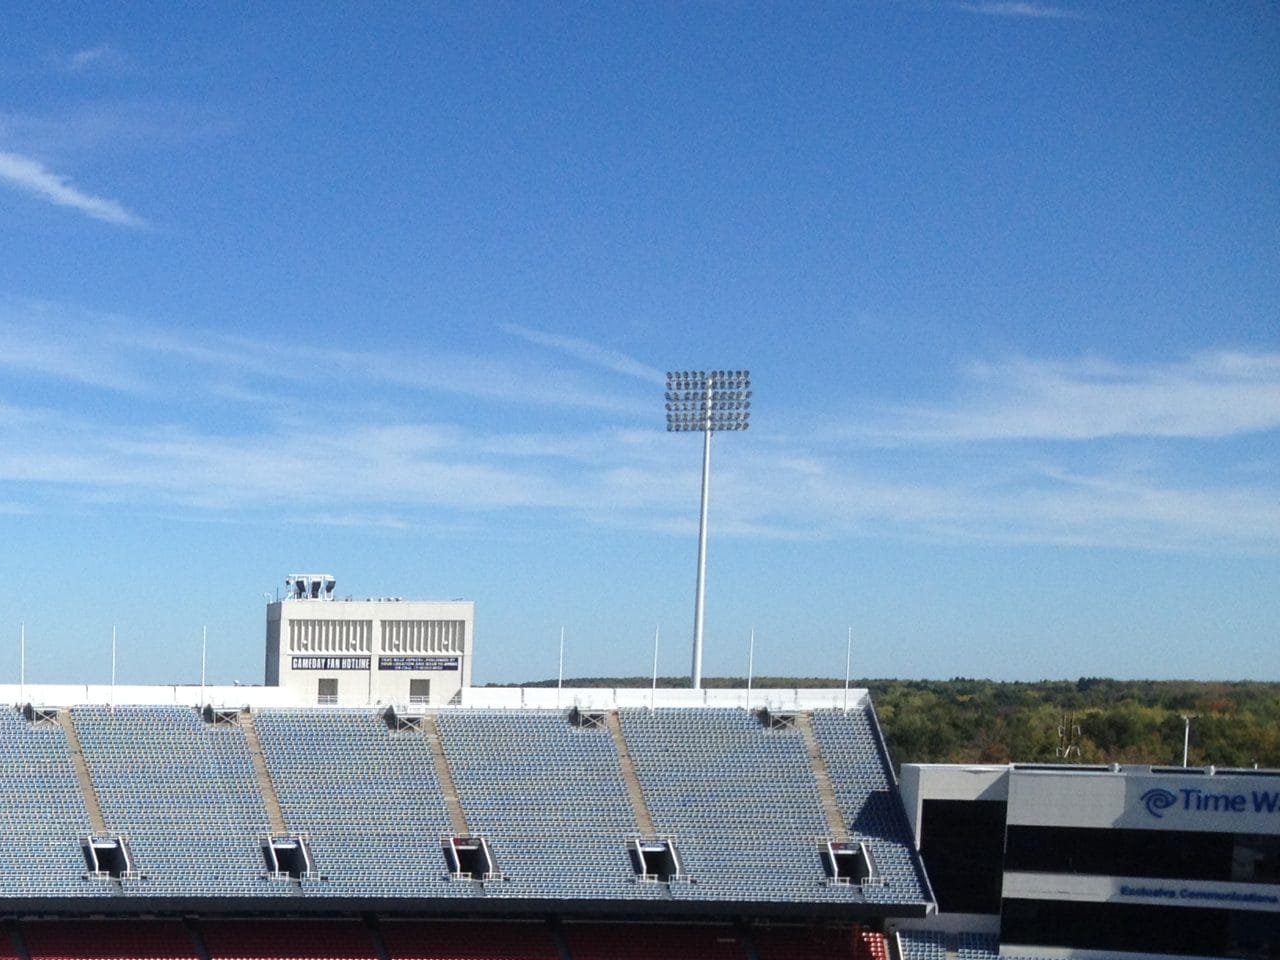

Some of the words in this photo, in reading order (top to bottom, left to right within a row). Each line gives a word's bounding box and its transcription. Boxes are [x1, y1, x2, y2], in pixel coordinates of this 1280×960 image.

[293, 658, 326, 669] GAMEDAY
[327, 658, 340, 669] FAN
[341, 658, 369, 669] HOTLINE
[1179, 789, 1246, 812] Time
[1252, 790, 1280, 813] W
[1121, 886, 1176, 898] Exclusive
